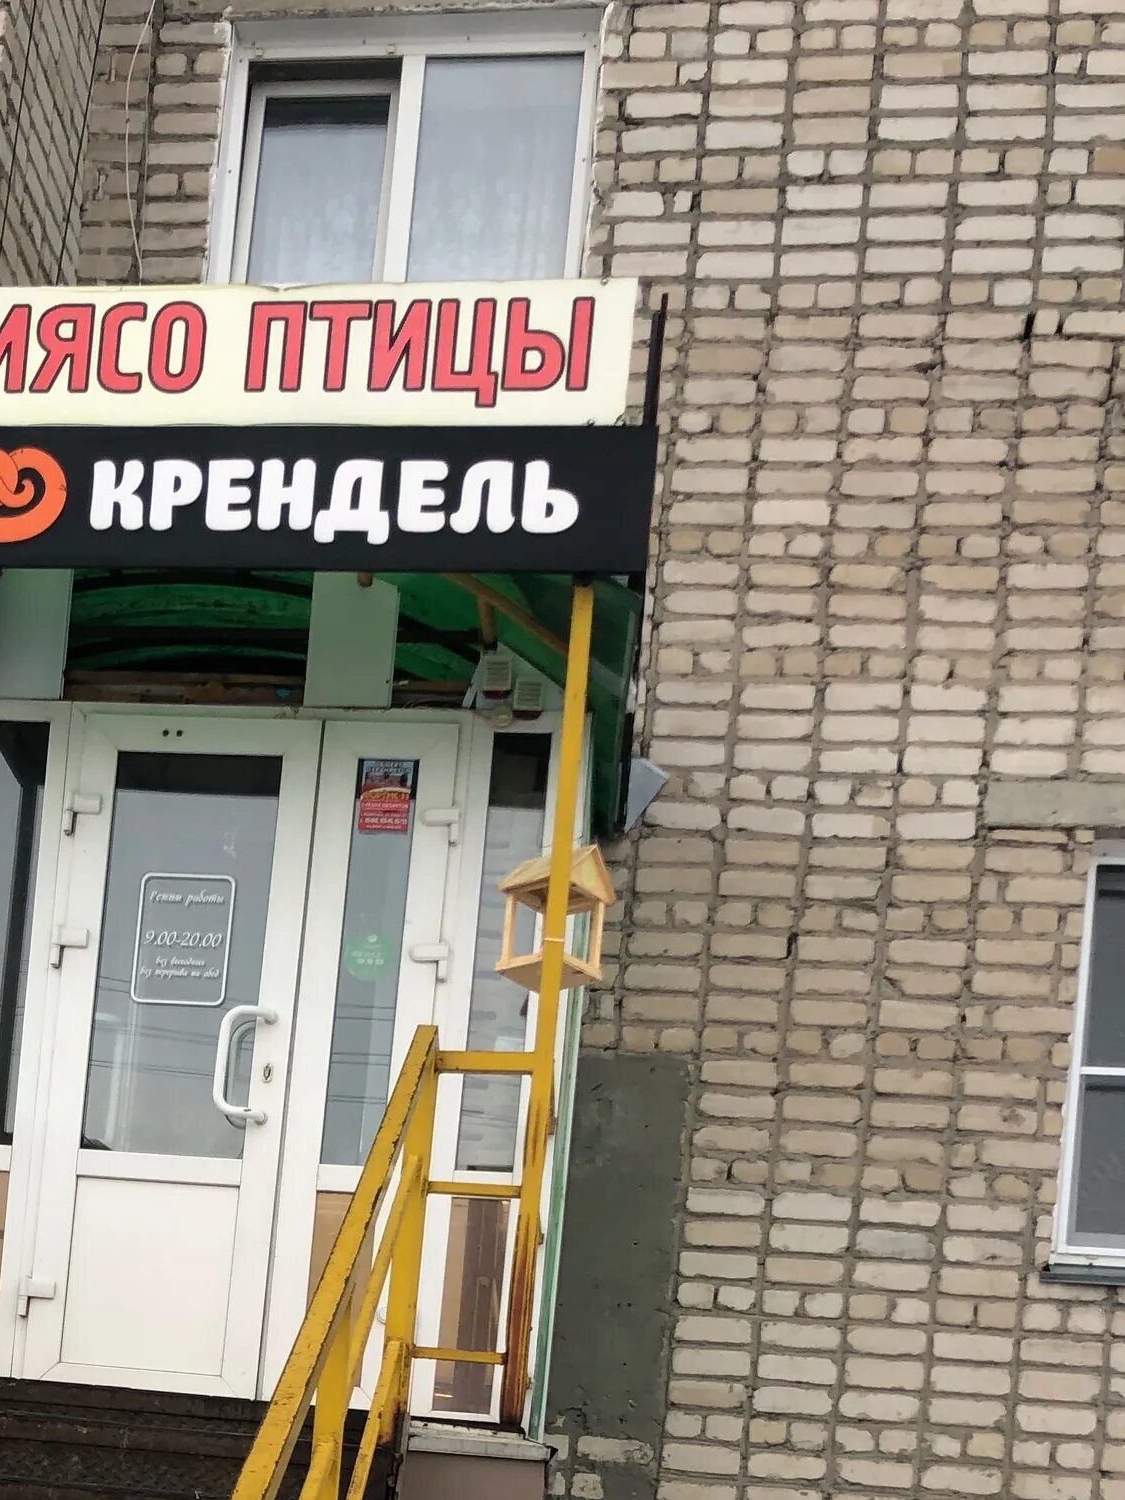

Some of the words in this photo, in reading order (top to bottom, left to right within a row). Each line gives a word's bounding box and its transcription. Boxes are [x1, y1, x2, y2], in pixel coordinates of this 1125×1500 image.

[244, 296, 595, 408] ПТИЦЫ
[88, 458, 579, 544] КРЕНДЕЛЬ
[185, 889, 225, 907] работы
[143, 930, 222, 948] 9.00-20.00
